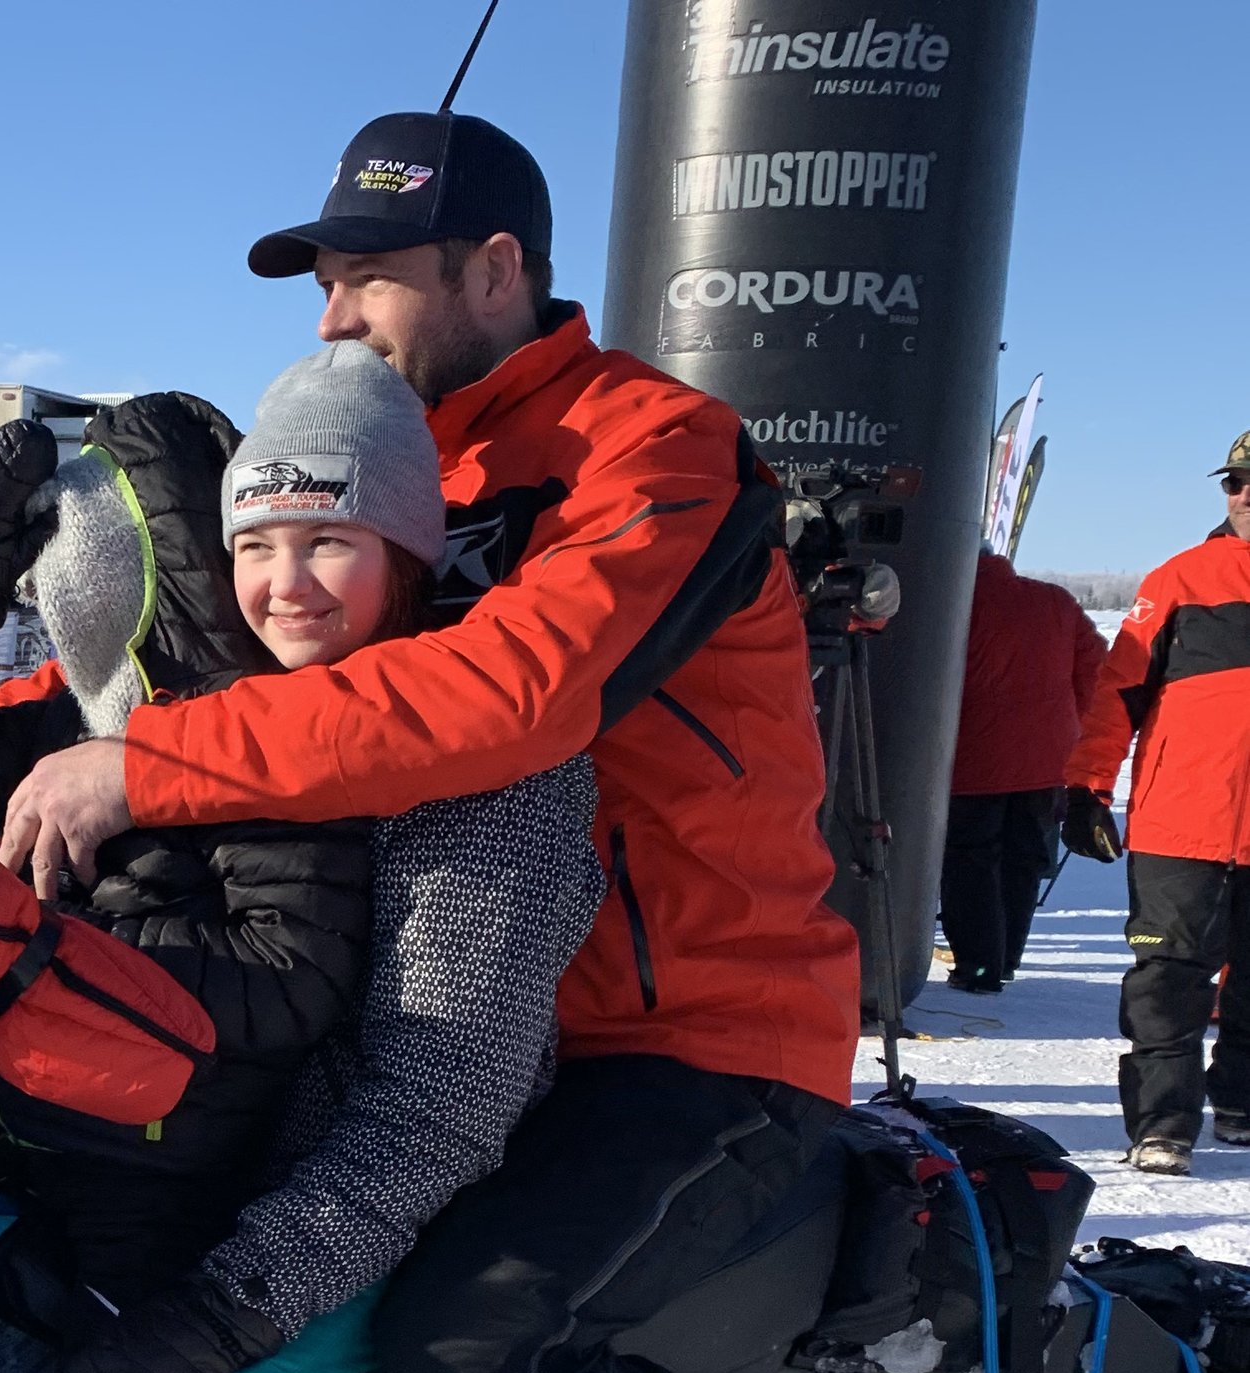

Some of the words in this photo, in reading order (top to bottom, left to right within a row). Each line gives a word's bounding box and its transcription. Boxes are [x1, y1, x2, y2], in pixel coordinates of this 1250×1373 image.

[813, 79, 942, 99] INSULATION
[368, 159, 405, 173] TEAM
[675, 150, 928, 216] WINDSTOPPER
[667, 270, 920, 316] CORDURA
[742, 410, 888, 447] otchlite
